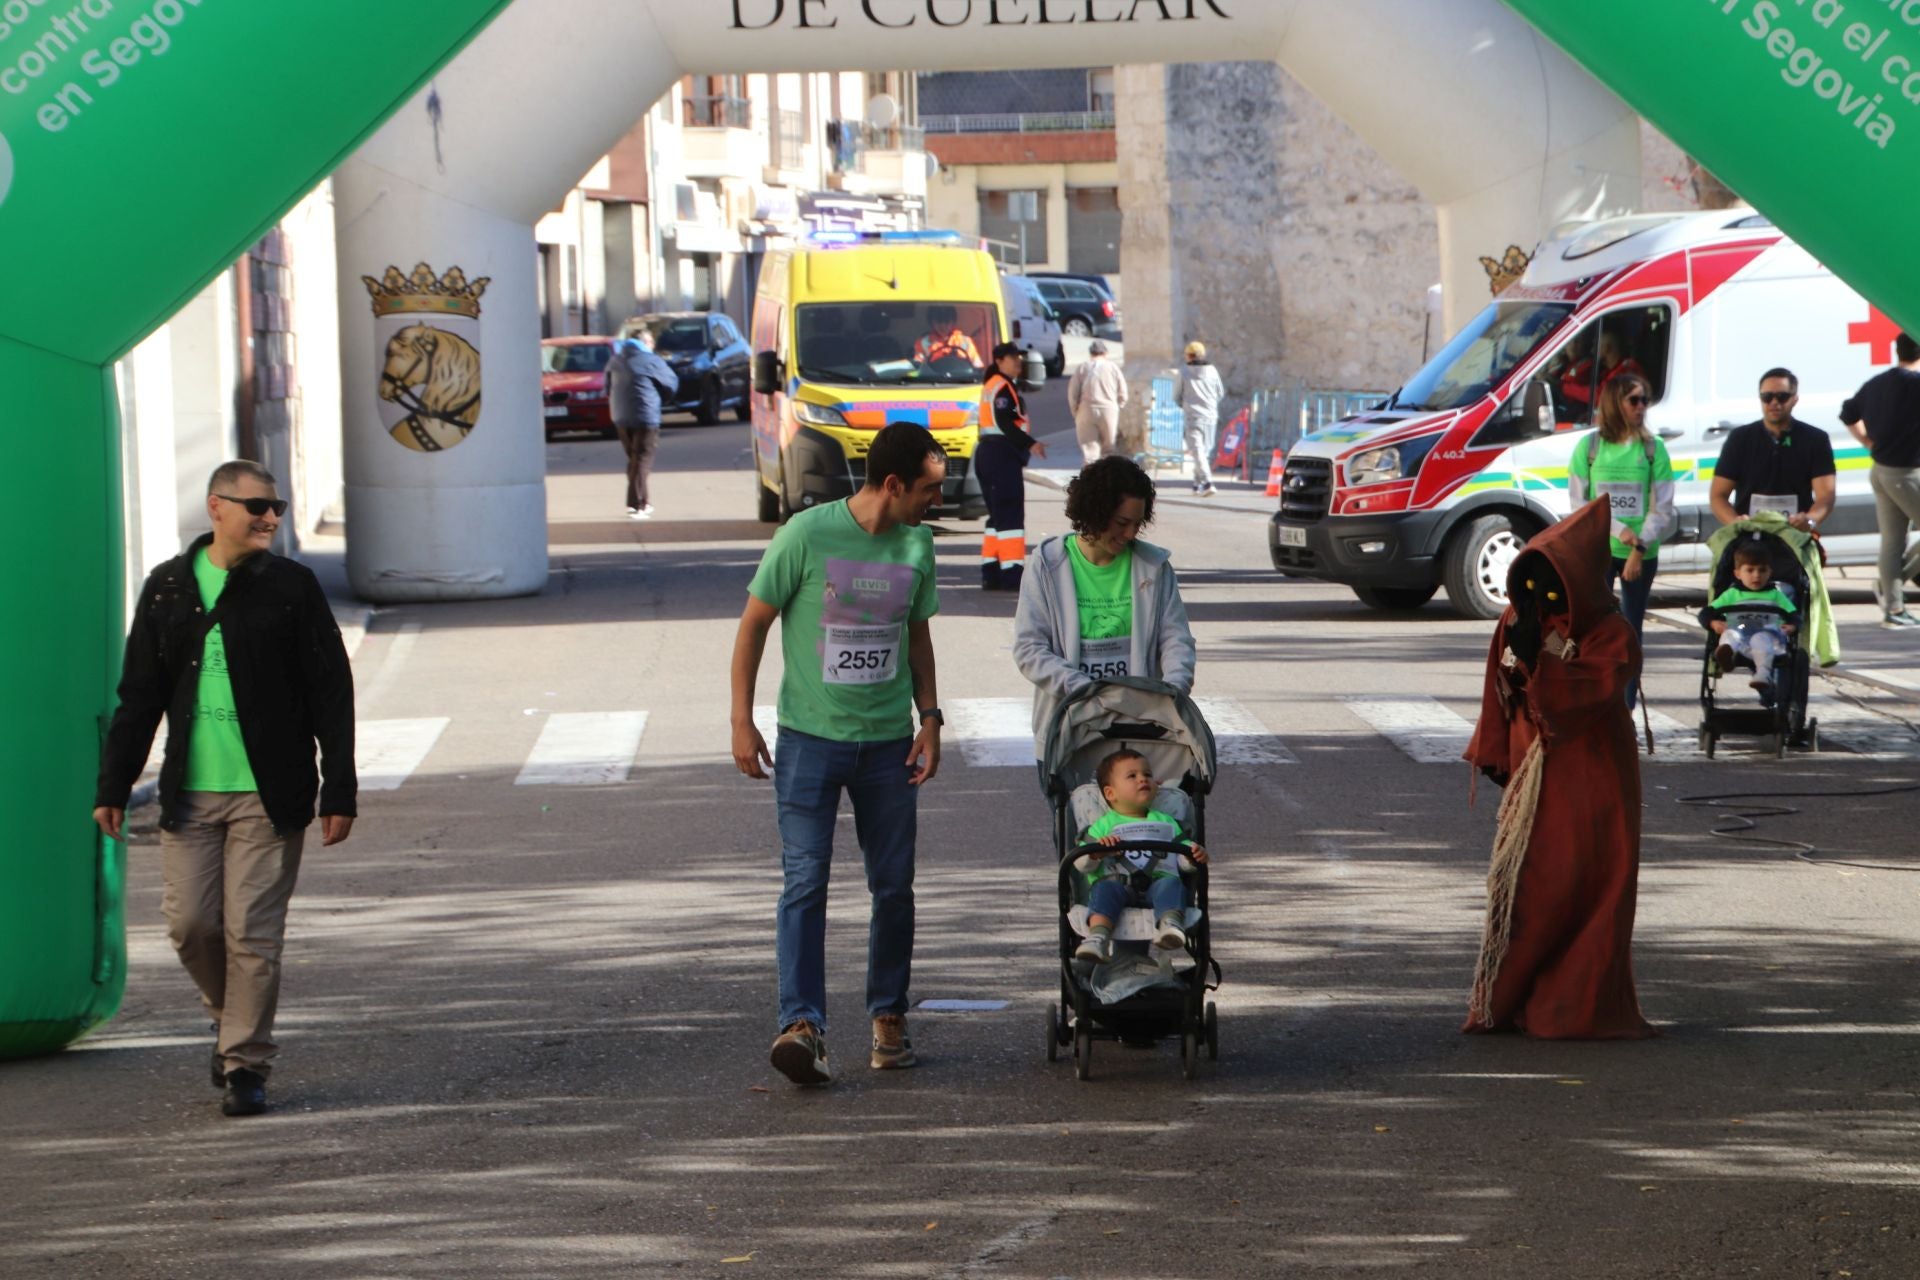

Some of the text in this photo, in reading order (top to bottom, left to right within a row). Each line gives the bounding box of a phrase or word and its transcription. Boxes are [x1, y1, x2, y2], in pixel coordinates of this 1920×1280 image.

[0, 0, 113, 94] contra
[37, 0, 207, 132] en Sego
[1741, 0, 1896, 149] Segovia
[1842, 22, 1892, 62] el
[1609, 496, 1637, 509] 562
[838, 649, 891, 670] 2557
